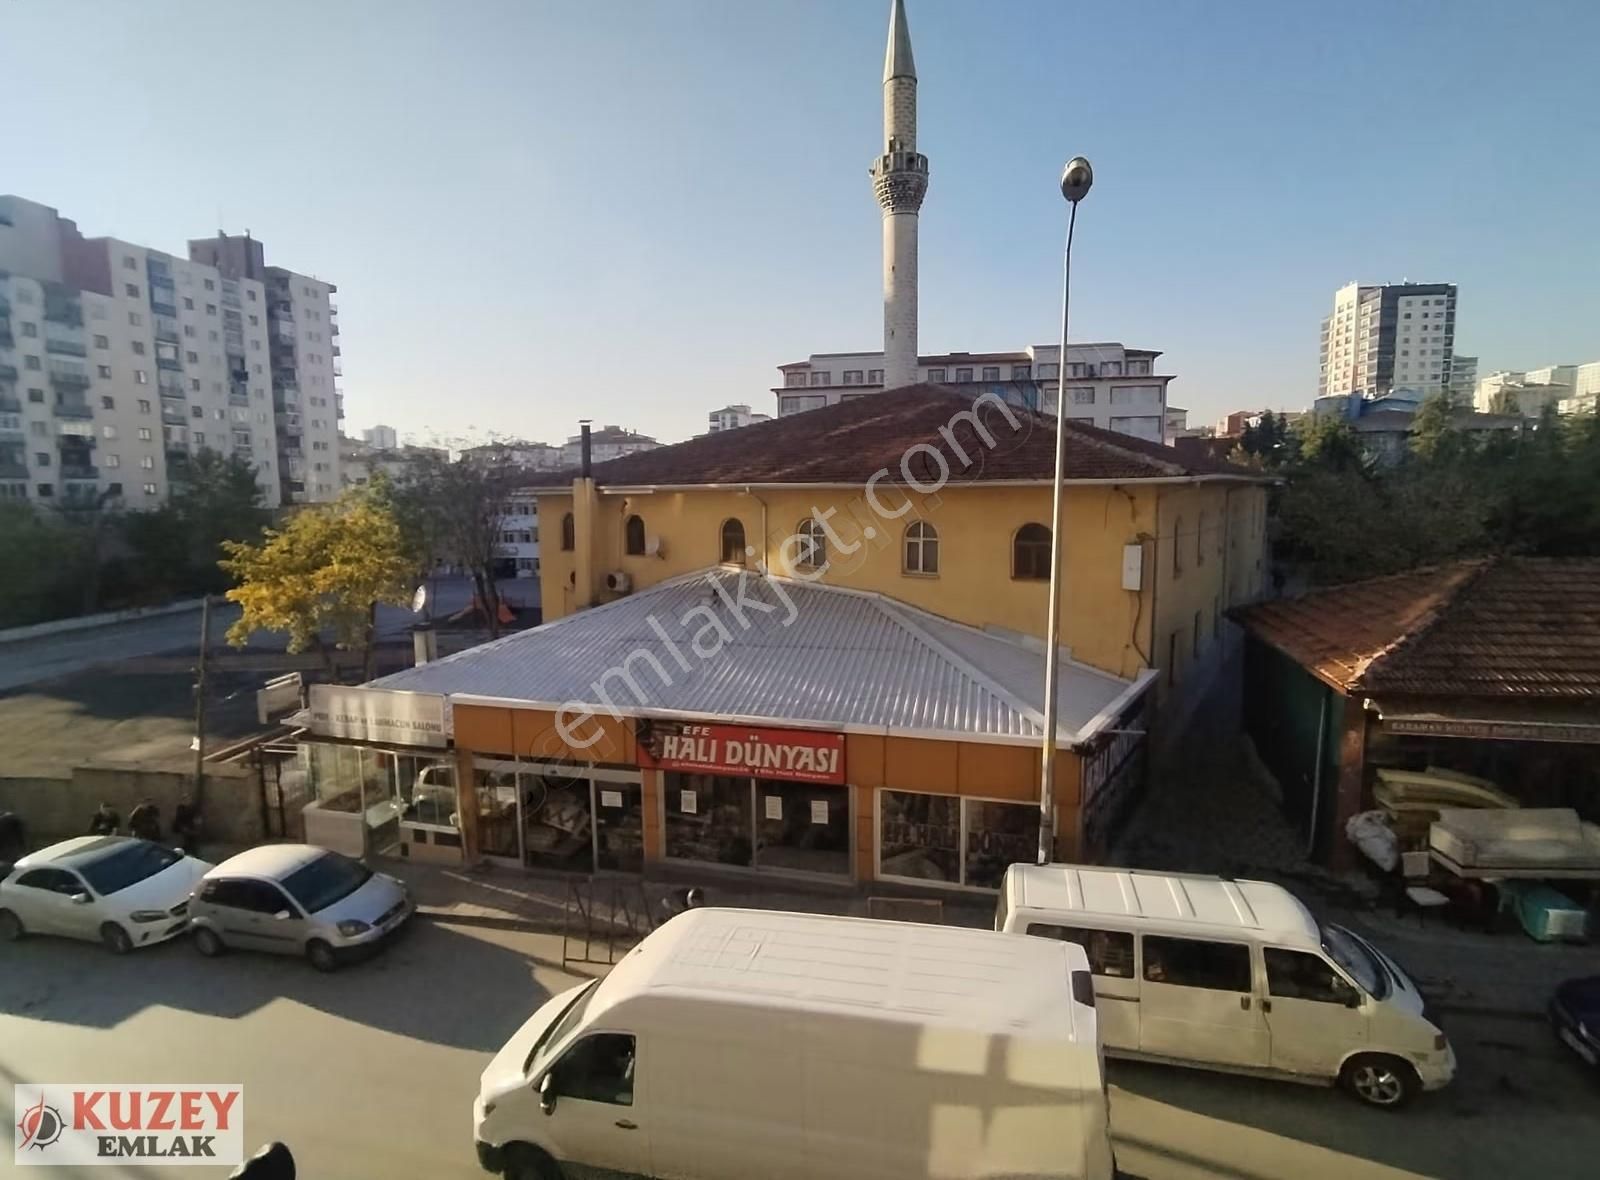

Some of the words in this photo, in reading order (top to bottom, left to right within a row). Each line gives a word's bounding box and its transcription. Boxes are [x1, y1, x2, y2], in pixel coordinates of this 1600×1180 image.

[412, 720, 442, 733] SALONU
[682, 725, 711, 736] EFE
[662, 735, 717, 763] HALI
[725, 736, 839, 773] DÜNYASI
